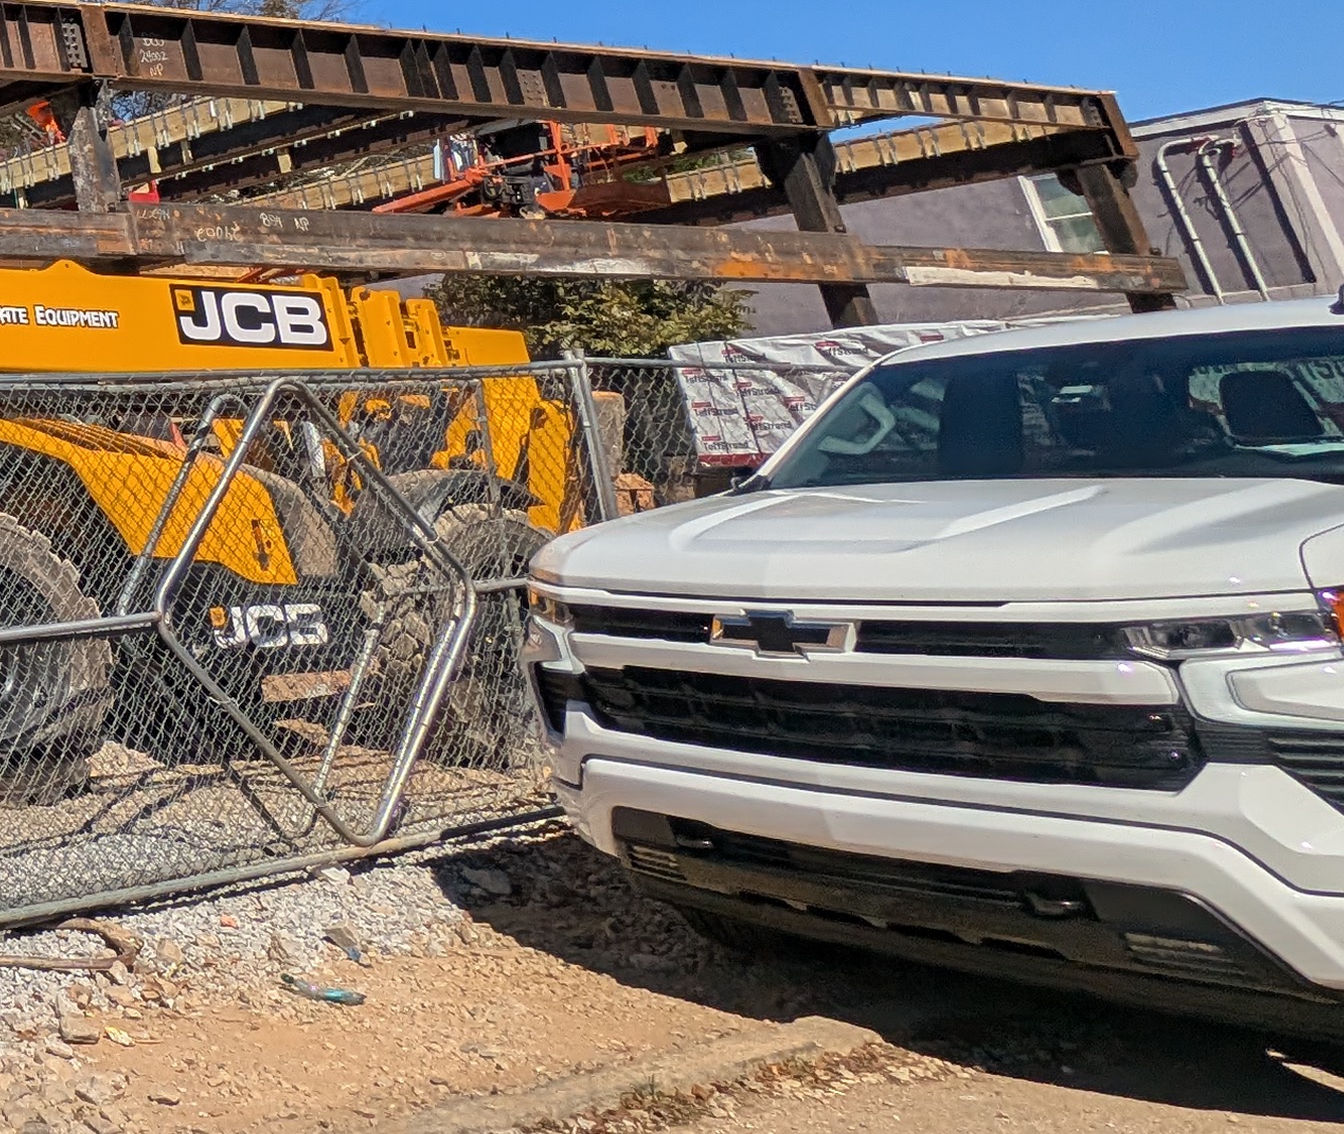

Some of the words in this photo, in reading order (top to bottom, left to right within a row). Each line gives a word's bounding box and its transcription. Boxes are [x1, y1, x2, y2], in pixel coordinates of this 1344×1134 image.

[34, 305, 119, 328] EQUIPMENT
[180, 291, 327, 344] JCB
[214, 604, 328, 649] JCB
